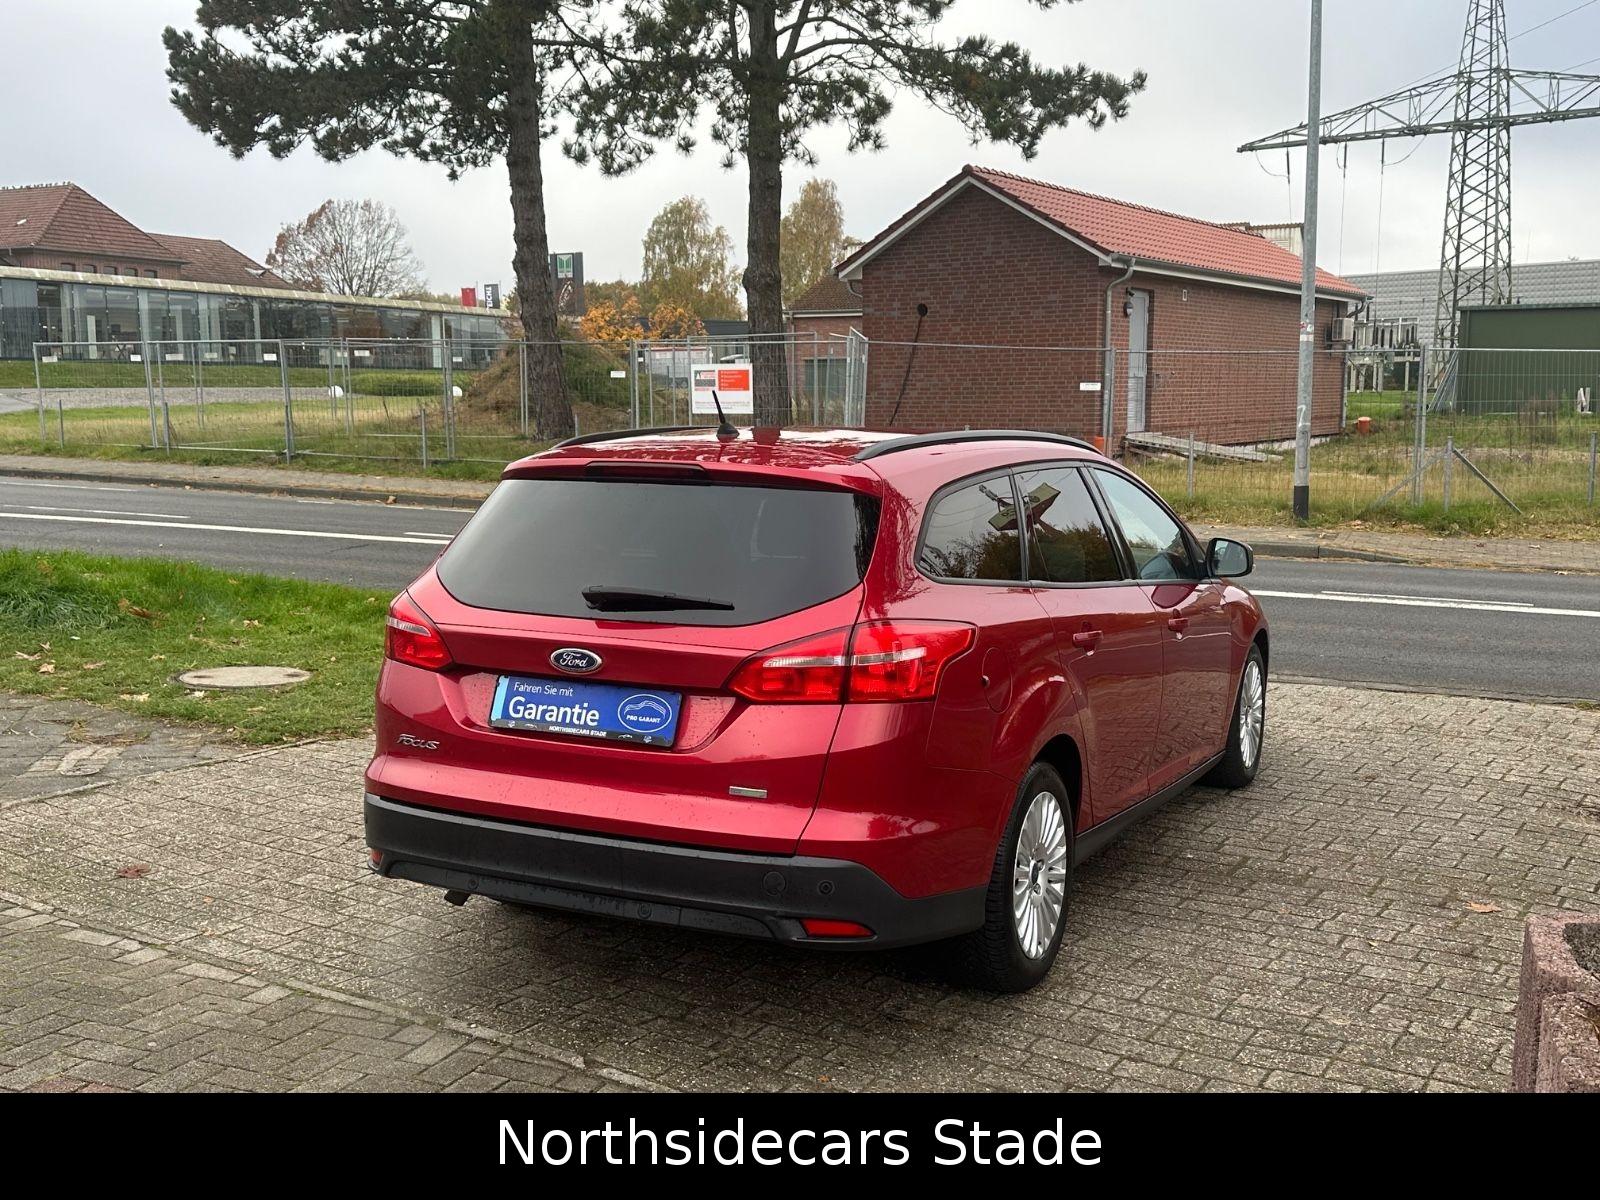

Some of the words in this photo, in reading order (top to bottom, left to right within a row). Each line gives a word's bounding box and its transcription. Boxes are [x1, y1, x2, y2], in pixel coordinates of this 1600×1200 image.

[560, 652, 589, 667] Ford
[514, 682, 542, 694] Fahren
[544, 685, 557, 695] Sie
[559, 687, 573, 697] mit
[508, 695, 600, 726] Garantie
[638, 716, 661, 724] GARANT
[549, 725, 590, 735] NORTHSIDECARS
[590, 729, 607, 737] STADE
